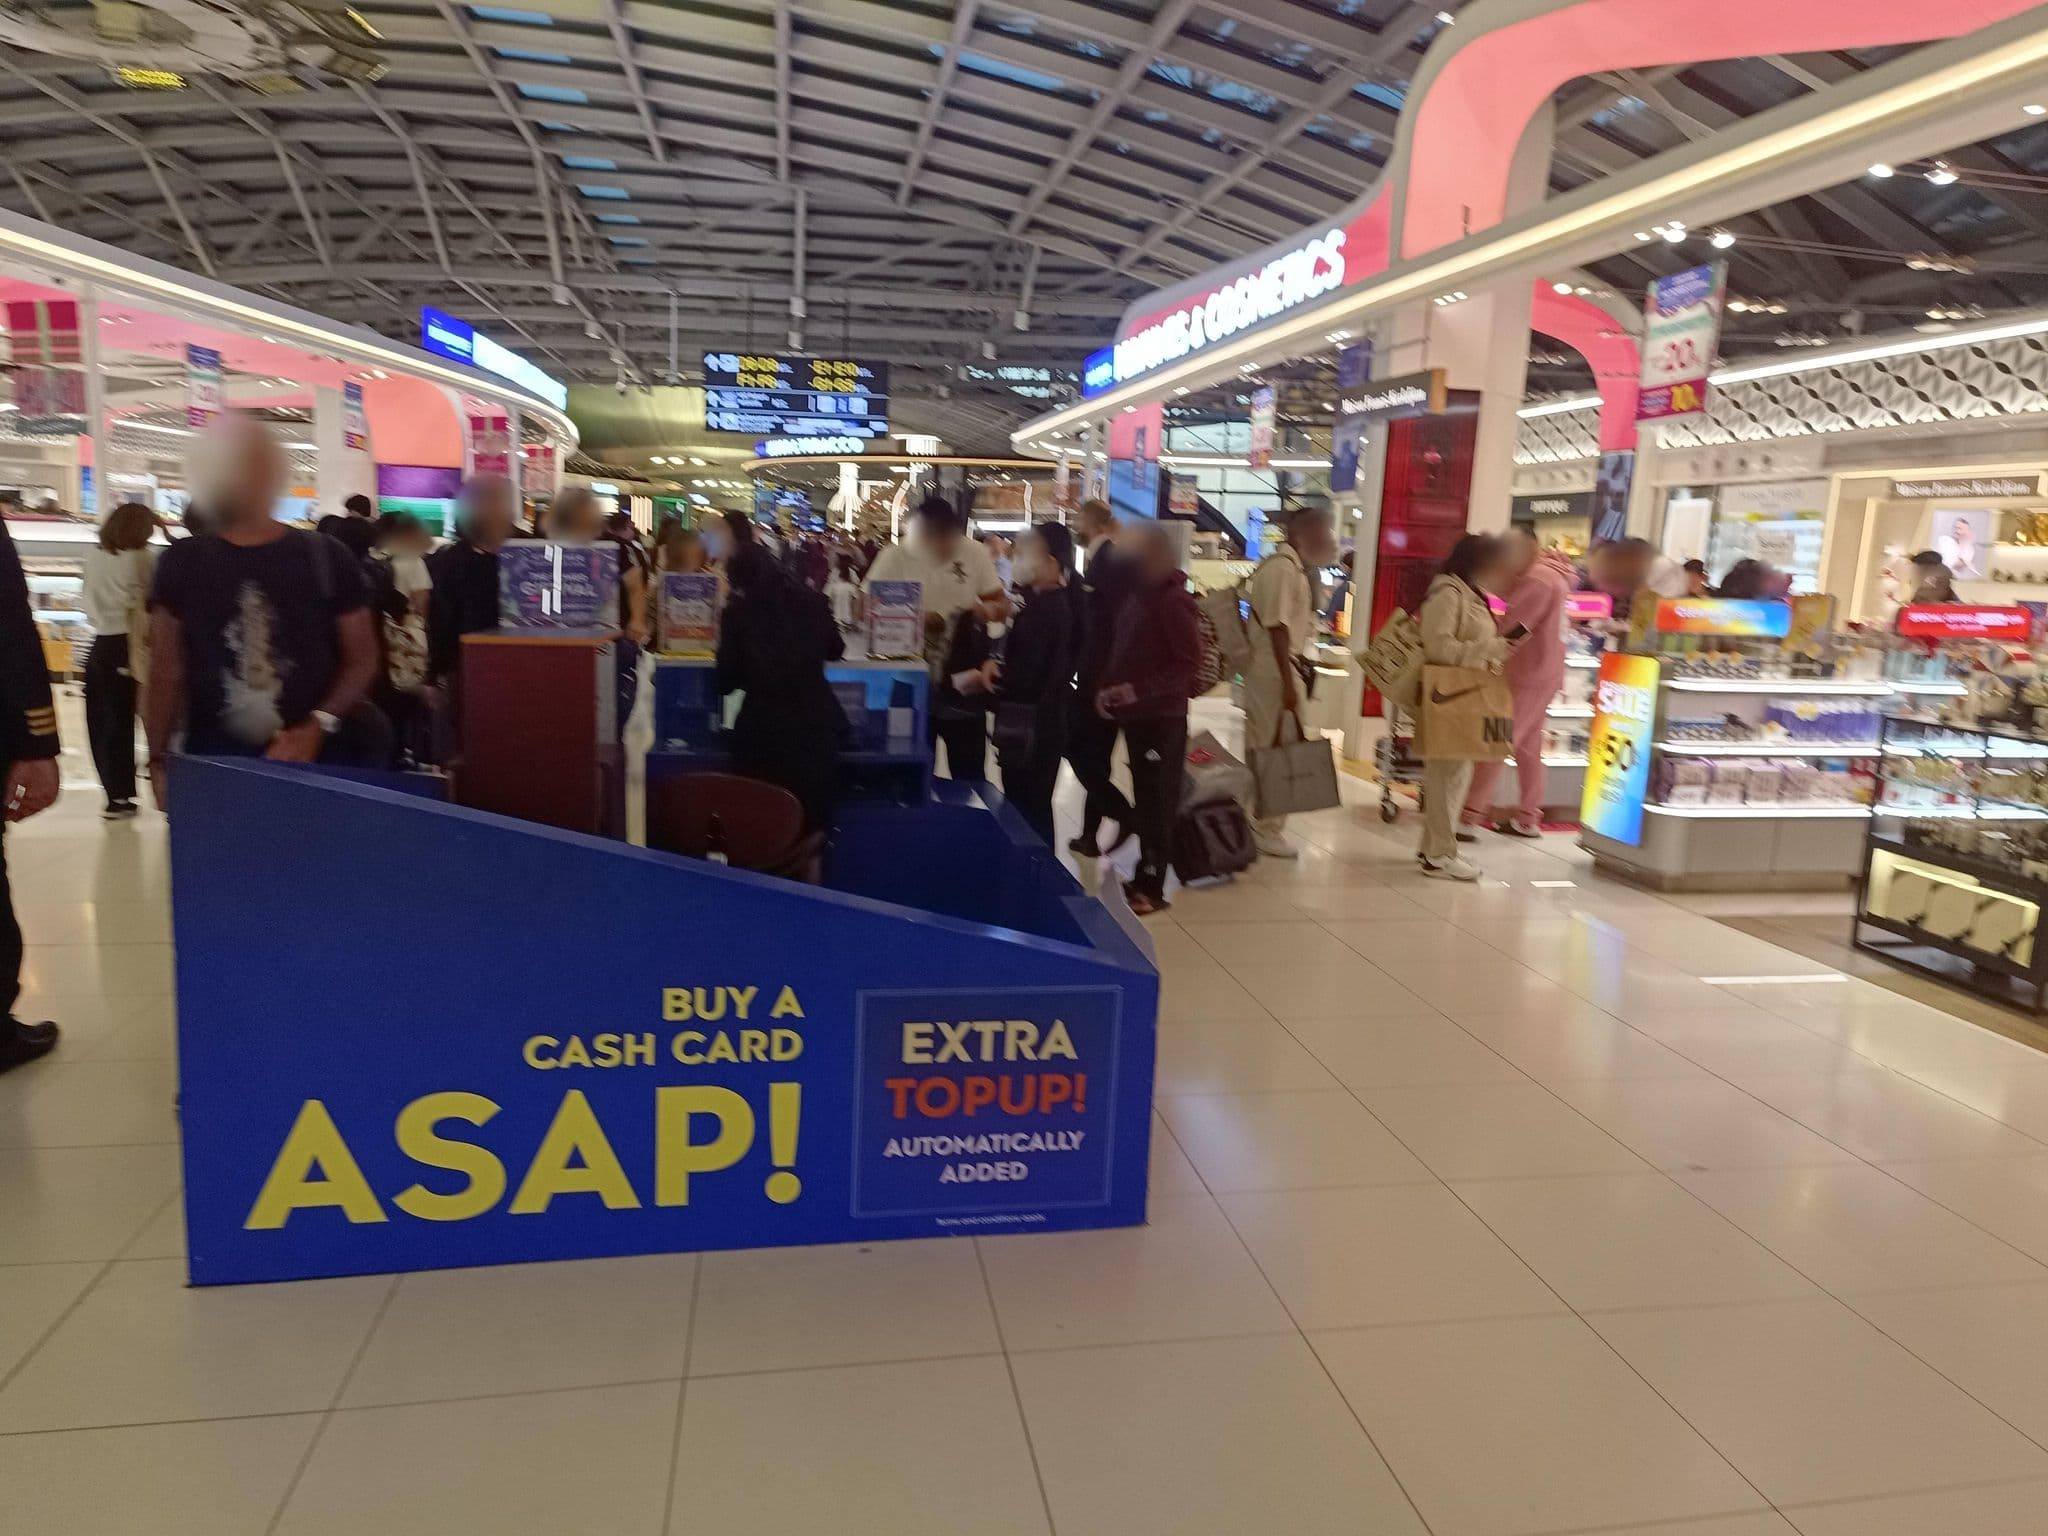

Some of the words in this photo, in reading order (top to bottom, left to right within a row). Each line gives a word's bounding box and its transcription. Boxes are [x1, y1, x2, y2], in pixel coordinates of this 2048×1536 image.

[797, 437, 865, 454] TOBACCO
[662, 987, 758, 1022] BUY
[770, 987, 805, 1019] A
[523, 1034, 656, 1070] CASH
[672, 1029, 804, 1066] CARD
[902, 1020, 1077, 1064] EXTRA
[886, 1073, 1088, 1120] TOPUP!
[245, 1082, 804, 1231] ASAP!
[883, 1129, 1085, 1159] AUTOMATICALLY
[939, 1161, 1029, 1184] ADDED
